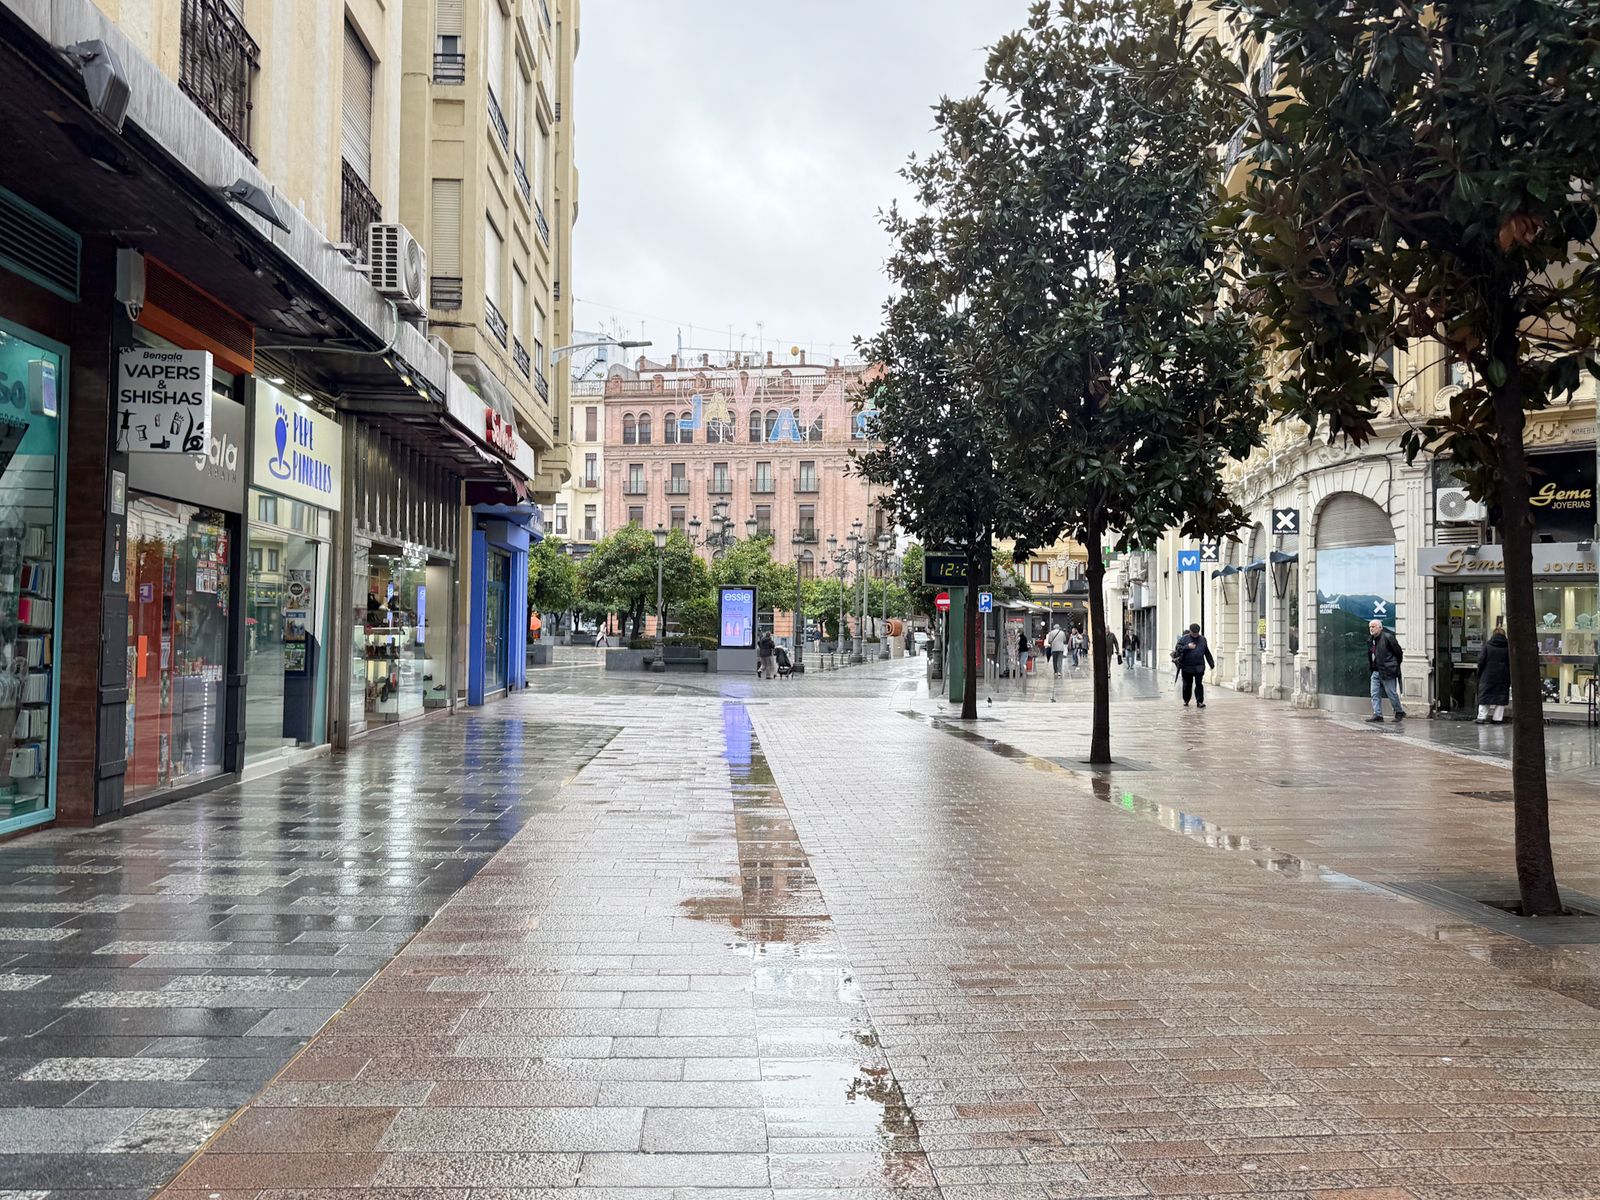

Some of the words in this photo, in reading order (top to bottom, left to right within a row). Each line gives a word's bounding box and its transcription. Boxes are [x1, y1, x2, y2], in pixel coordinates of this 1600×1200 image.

[143, 351, 183, 361] Bengala
[124, 363, 200, 380] VAPERS
[157, 380, 167, 389] &
[120, 389, 203, 406] SHISHAS
[293, 411, 314, 451] PEPE
[195, 433, 238, 472] gala
[292, 449, 332, 494] PINRELES
[1528, 482, 1592, 506] Gema
[1551, 500, 1591, 509] JOYERIAS
[940, 563, 980, 577] 12:2
[1431, 549, 1504, 575] Gema
[724, 592, 751, 601] essie
[981, 595, 990, 606] P
